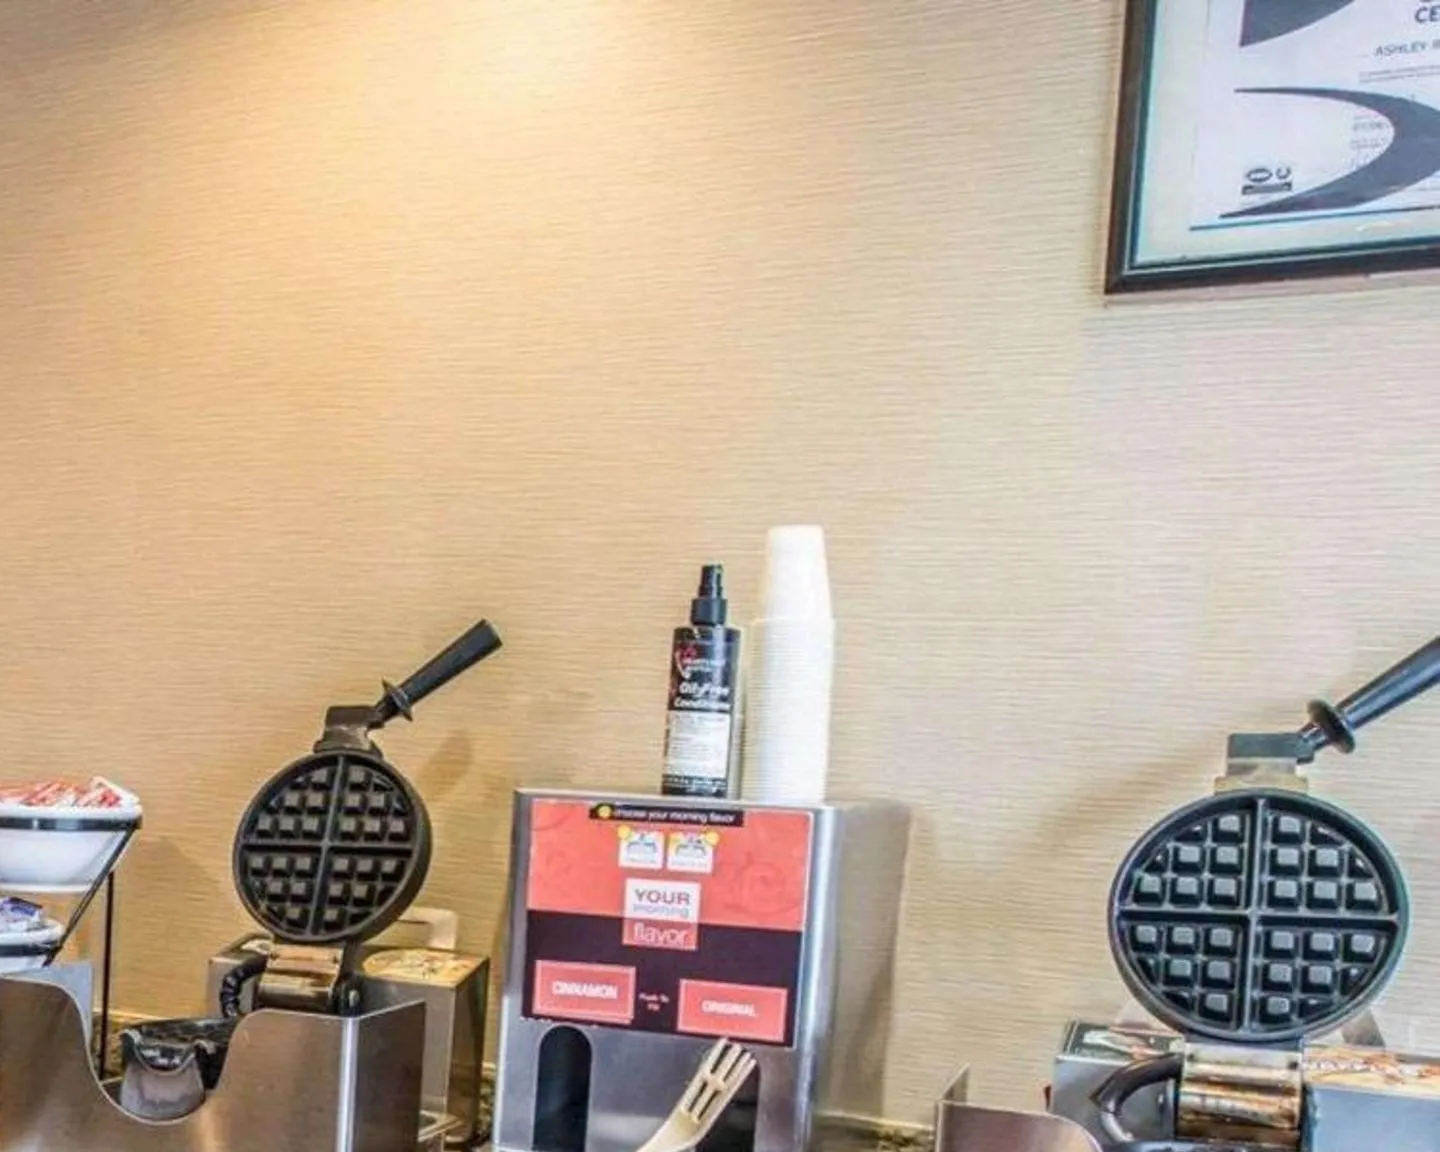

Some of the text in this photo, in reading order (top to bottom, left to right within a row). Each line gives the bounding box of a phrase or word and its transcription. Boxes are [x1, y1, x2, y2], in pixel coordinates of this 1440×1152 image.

[634, 888, 690, 906] YOUR
[634, 922, 689, 946] flavor
[552, 980, 618, 1000] CINNAMON
[701, 999, 757, 1018] ORIGINAL
